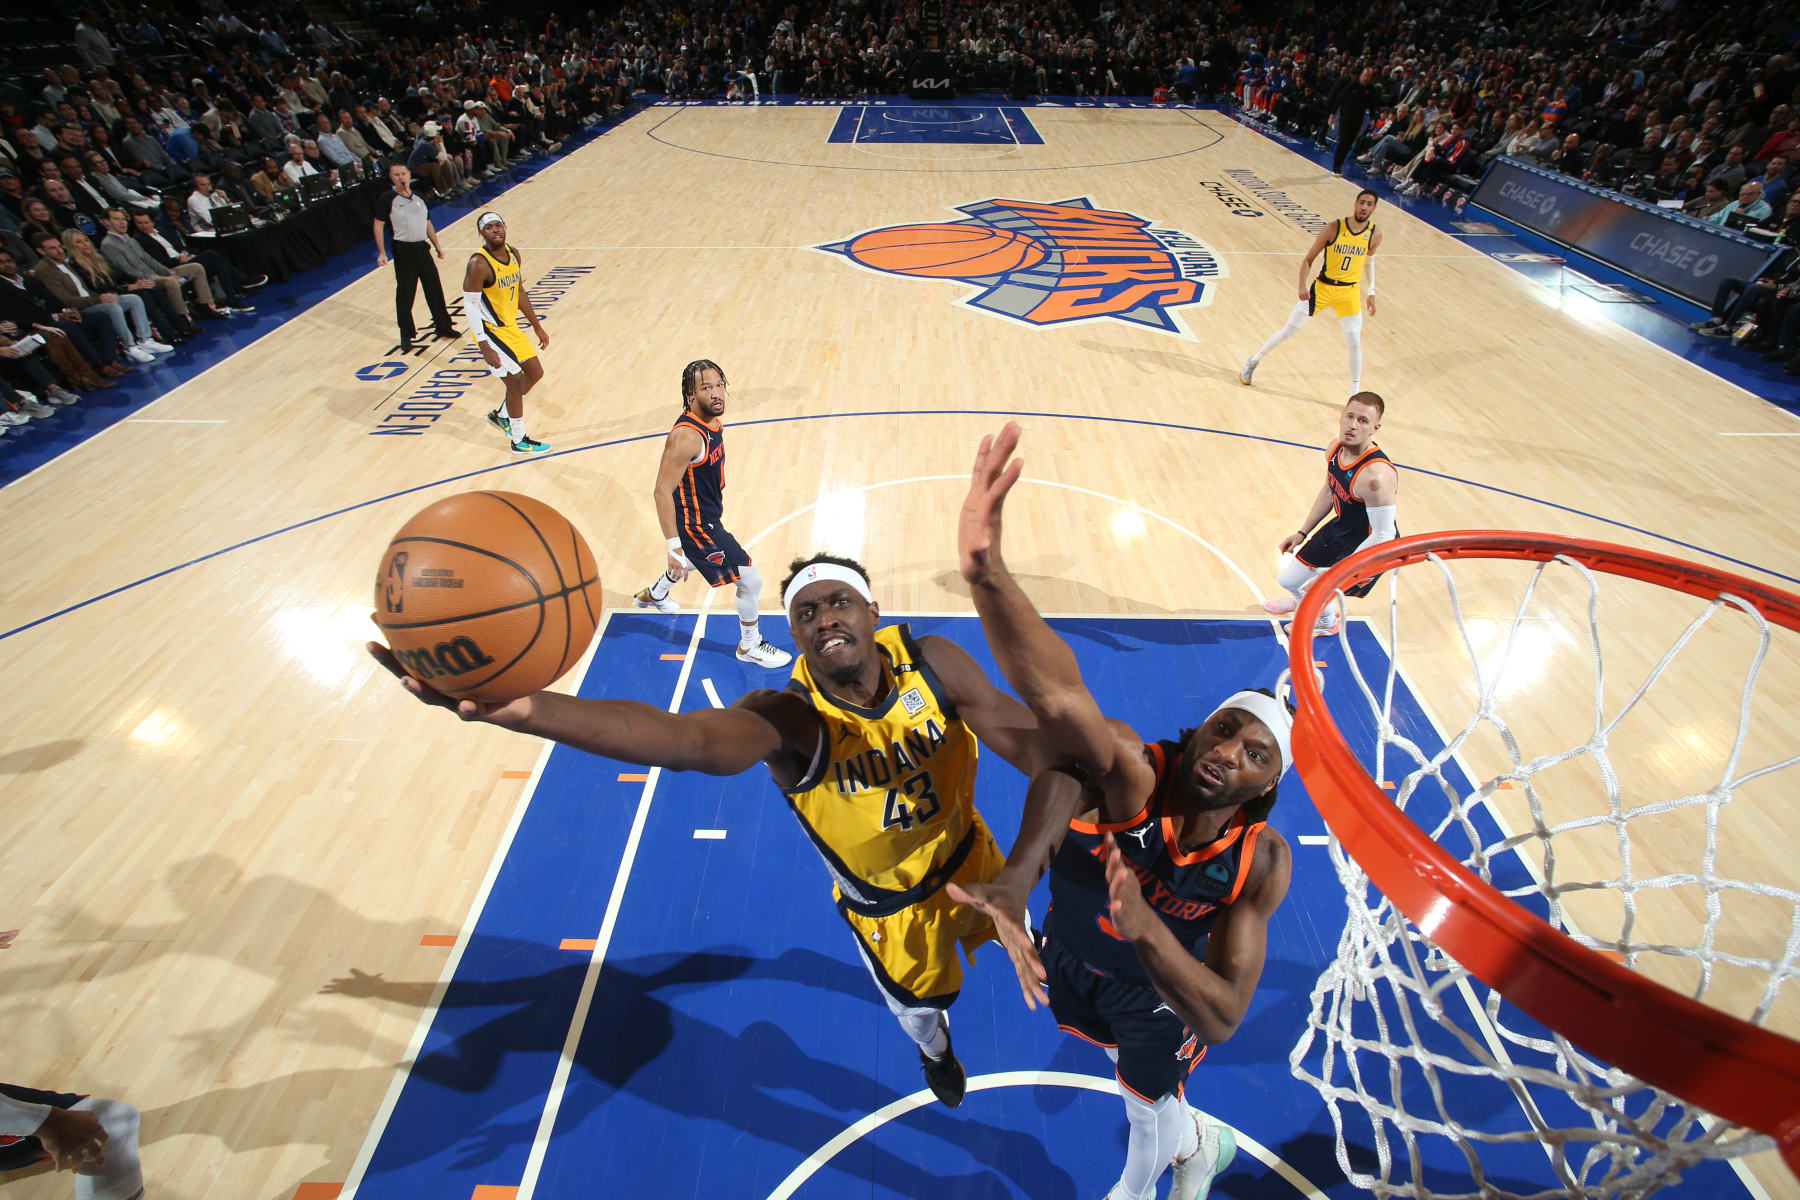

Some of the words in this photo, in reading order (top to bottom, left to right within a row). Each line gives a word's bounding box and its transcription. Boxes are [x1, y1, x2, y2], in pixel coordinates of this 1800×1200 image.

[1199, 180, 1252, 208] CHASE
[1221, 168, 1275, 190] MADISON
[1252, 190, 1308, 212] SQUARE
[1499, 180, 1545, 209] CHASE
[990, 198, 1198, 324] KNICKS
[1146, 228, 1204, 249] NEW
[1175, 250, 1219, 277] YORK
[1333, 243, 1367, 256] INDIANA
[1341, 256, 1352, 271] 0
[1630, 232, 1700, 270] CHASE
[497, 271, 520, 288] INDIAN
[510, 285, 515, 301] 7
[368, 368, 492, 436] GARDEN
[834, 718, 948, 794] INDANA
[882, 770, 941, 831] 43
[1148, 878, 1217, 921] YORK
